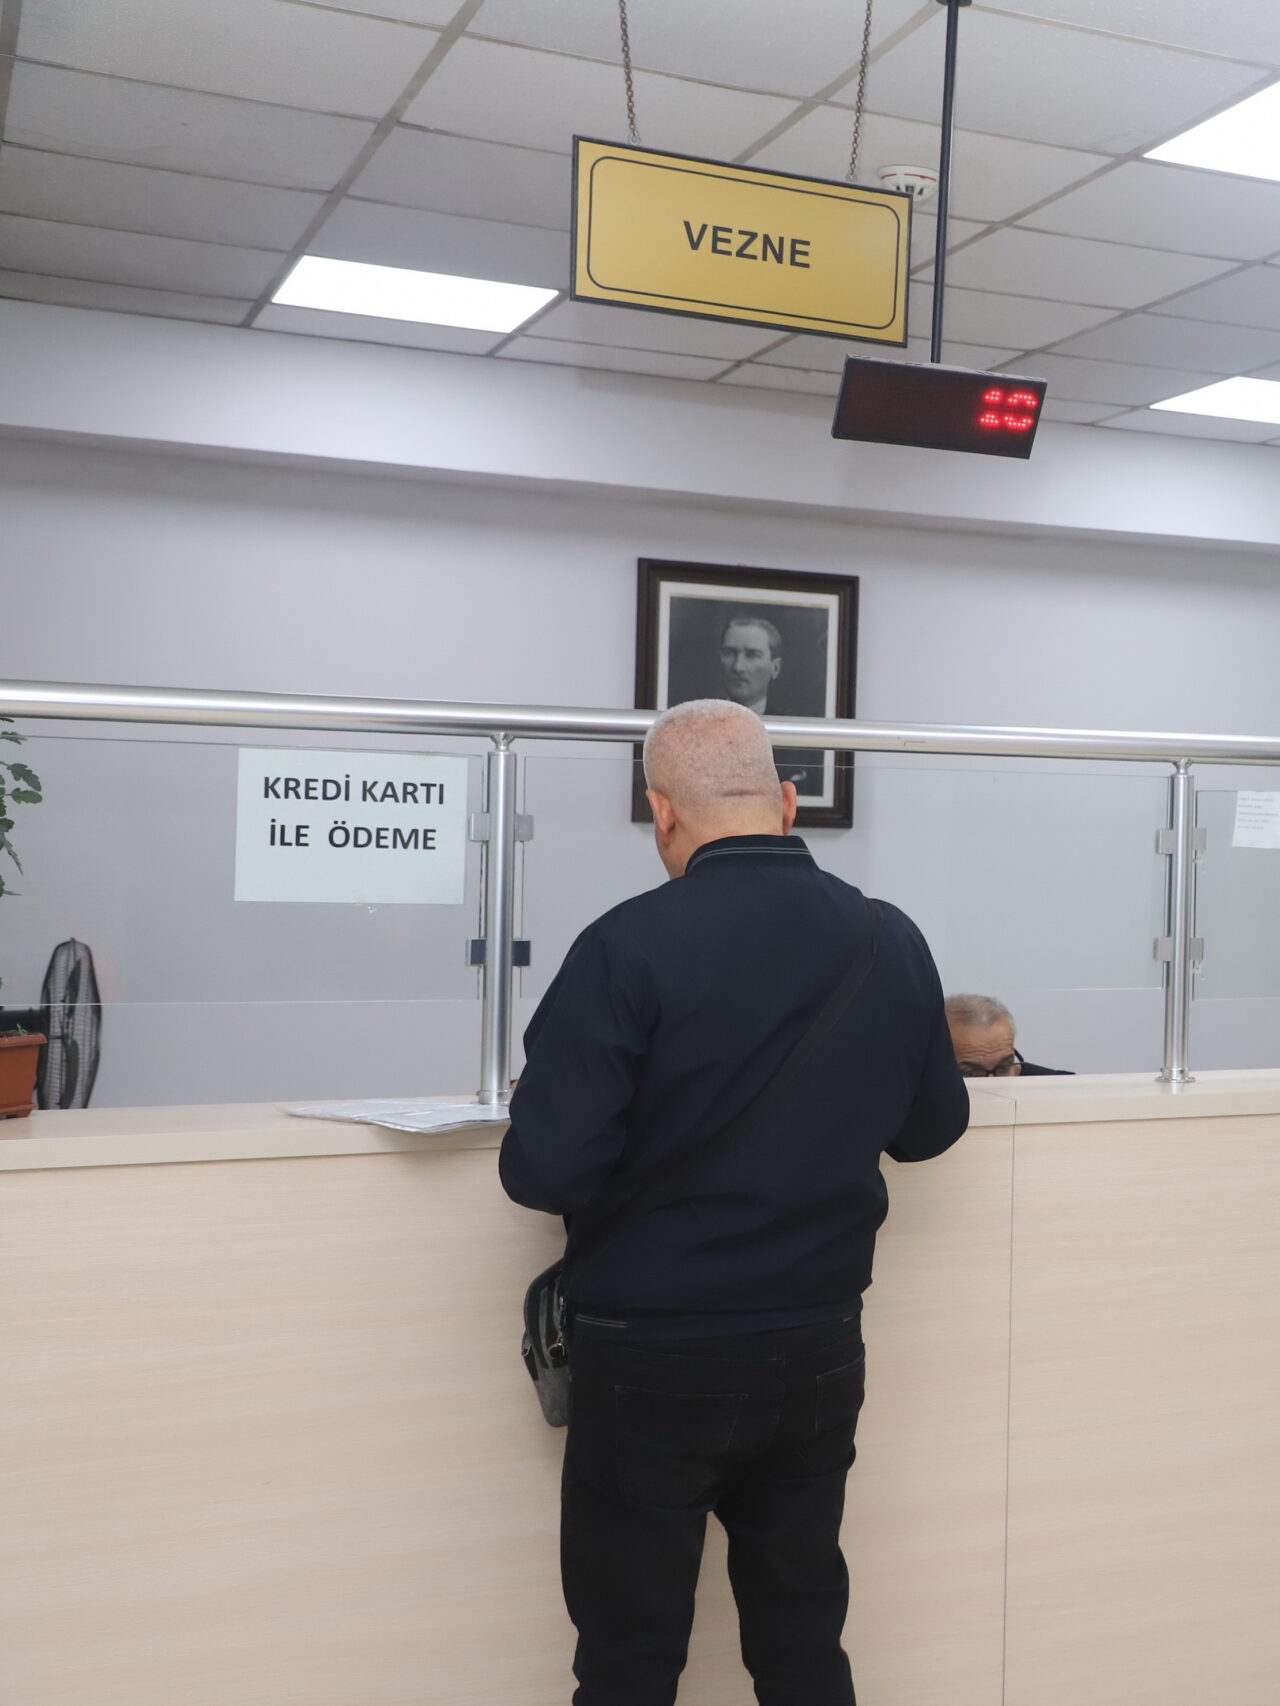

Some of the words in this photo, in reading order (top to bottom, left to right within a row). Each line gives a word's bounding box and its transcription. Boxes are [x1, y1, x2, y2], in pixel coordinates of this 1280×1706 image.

[683, 220, 812, 269] VEZNE
[263, 773, 351, 802] KREDİ
[361, 780, 445, 805] KARTI
[269, 818, 310, 847] İLE
[328, 820, 437, 850] ÖDEME
